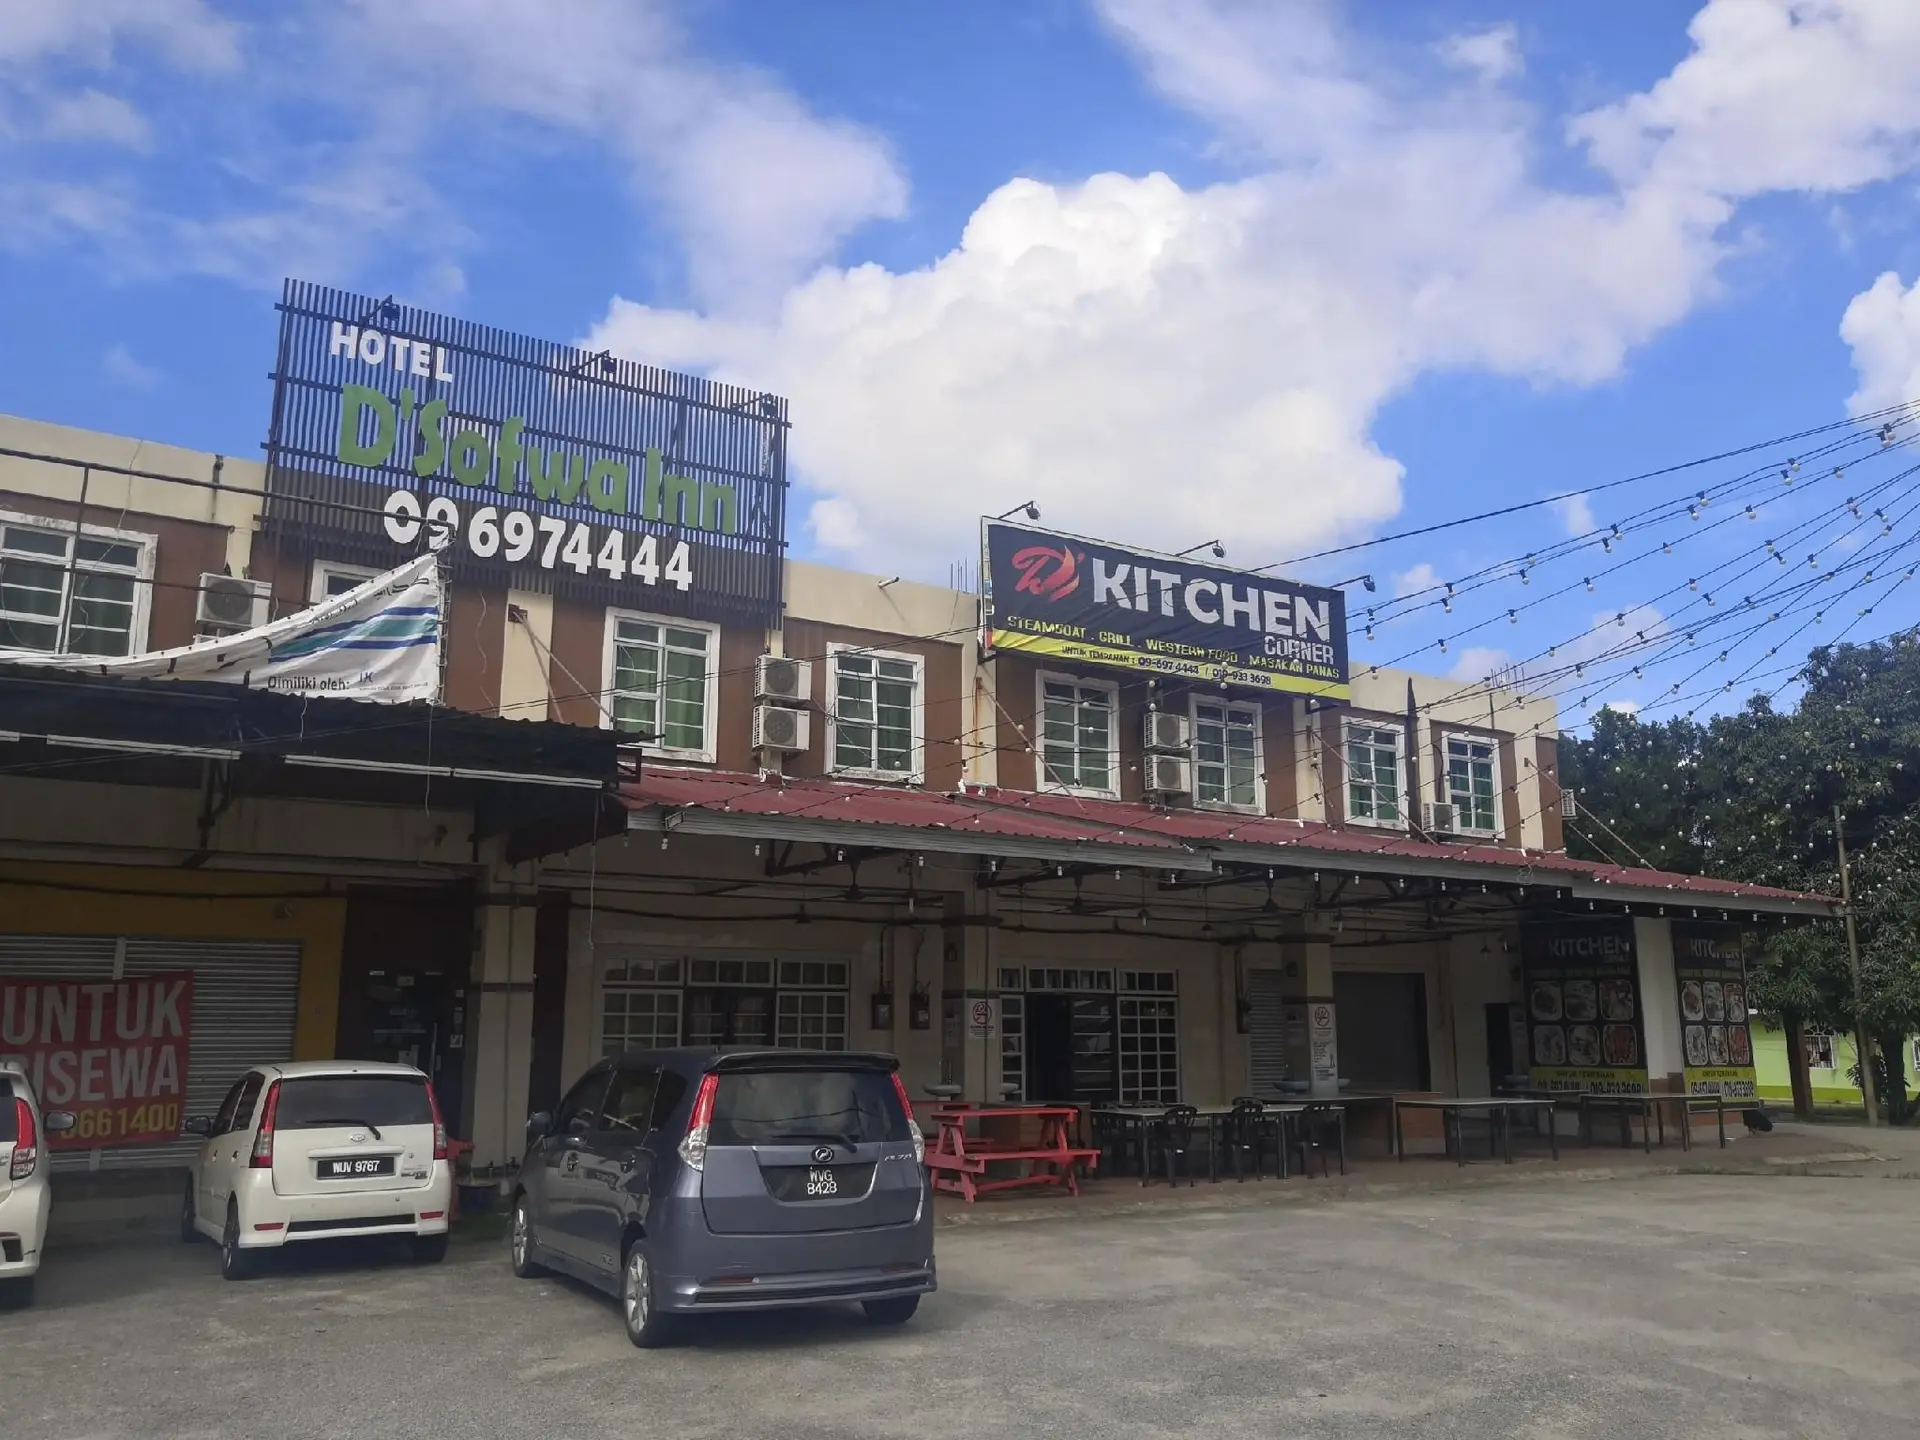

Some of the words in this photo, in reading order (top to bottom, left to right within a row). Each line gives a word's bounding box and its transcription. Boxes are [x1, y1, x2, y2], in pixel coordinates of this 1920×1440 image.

[331, 322, 453, 383] HOTEL
[337, 383, 630, 515] D'Sofwa
[642, 447, 738, 536] Inn
[383, 489, 459, 551] 09
[468, 507, 693, 592] 6974444
[1093, 557, 1331, 642] KITCHEN
[1007, 615, 1087, 639] STEAMBOAT
[1099, 631, 1134, 647] GRILL
[1145, 639, 1205, 657] WESTERN
[1207, 649, 1238, 664] FOOD
[1249, 655, 1303, 674] MASAKAN
[1306, 664, 1340, 679] PANAS
[1264, 635, 1334, 665] CORNER
[268, 675, 316, 690] Dimiliki
[1175, 662, 1199, 675] 4444
[1250, 674, 1272, 685] 3698
[2, 980, 187, 1046] UNTUK
[332, 1161, 352, 1174] WUV
[355, 1160, 380, 1173] 9767
[807, 1181, 838, 1196] 8428
[809, 1169, 833, 1183] WVG
